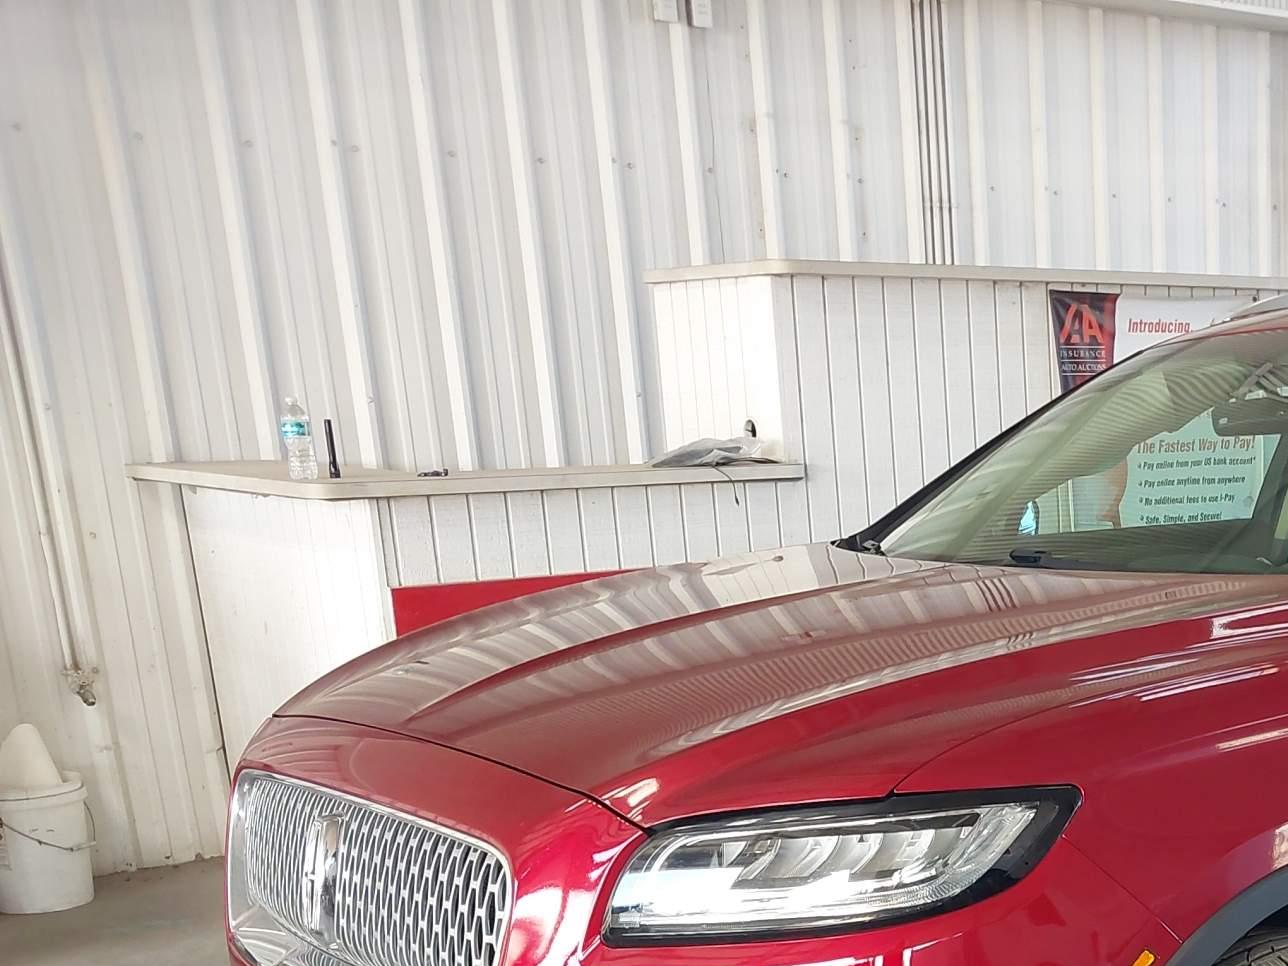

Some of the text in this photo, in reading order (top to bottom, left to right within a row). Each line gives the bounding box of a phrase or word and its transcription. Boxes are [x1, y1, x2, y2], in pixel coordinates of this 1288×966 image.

[1137, 434, 1256, 454] The Fastest Way to Pay!
[1143, 461, 1154, 471] Pay
[1176, 459, 1189, 468] from
[1204, 457, 1212, 466] US
[1213, 457, 1227, 466] bank
[1144, 480, 1155, 488] Pay
[1176, 476, 1200, 487] anytime
[1202, 476, 1216, 485] from
[1217, 475, 1246, 487] anywhere
[1145, 498, 1153, 506] No
[1154, 496, 1185, 505] additional
[1187, 495, 1199, 504] fees
[1201, 495, 1207, 503] to
[1188, 513, 1198, 522] and
